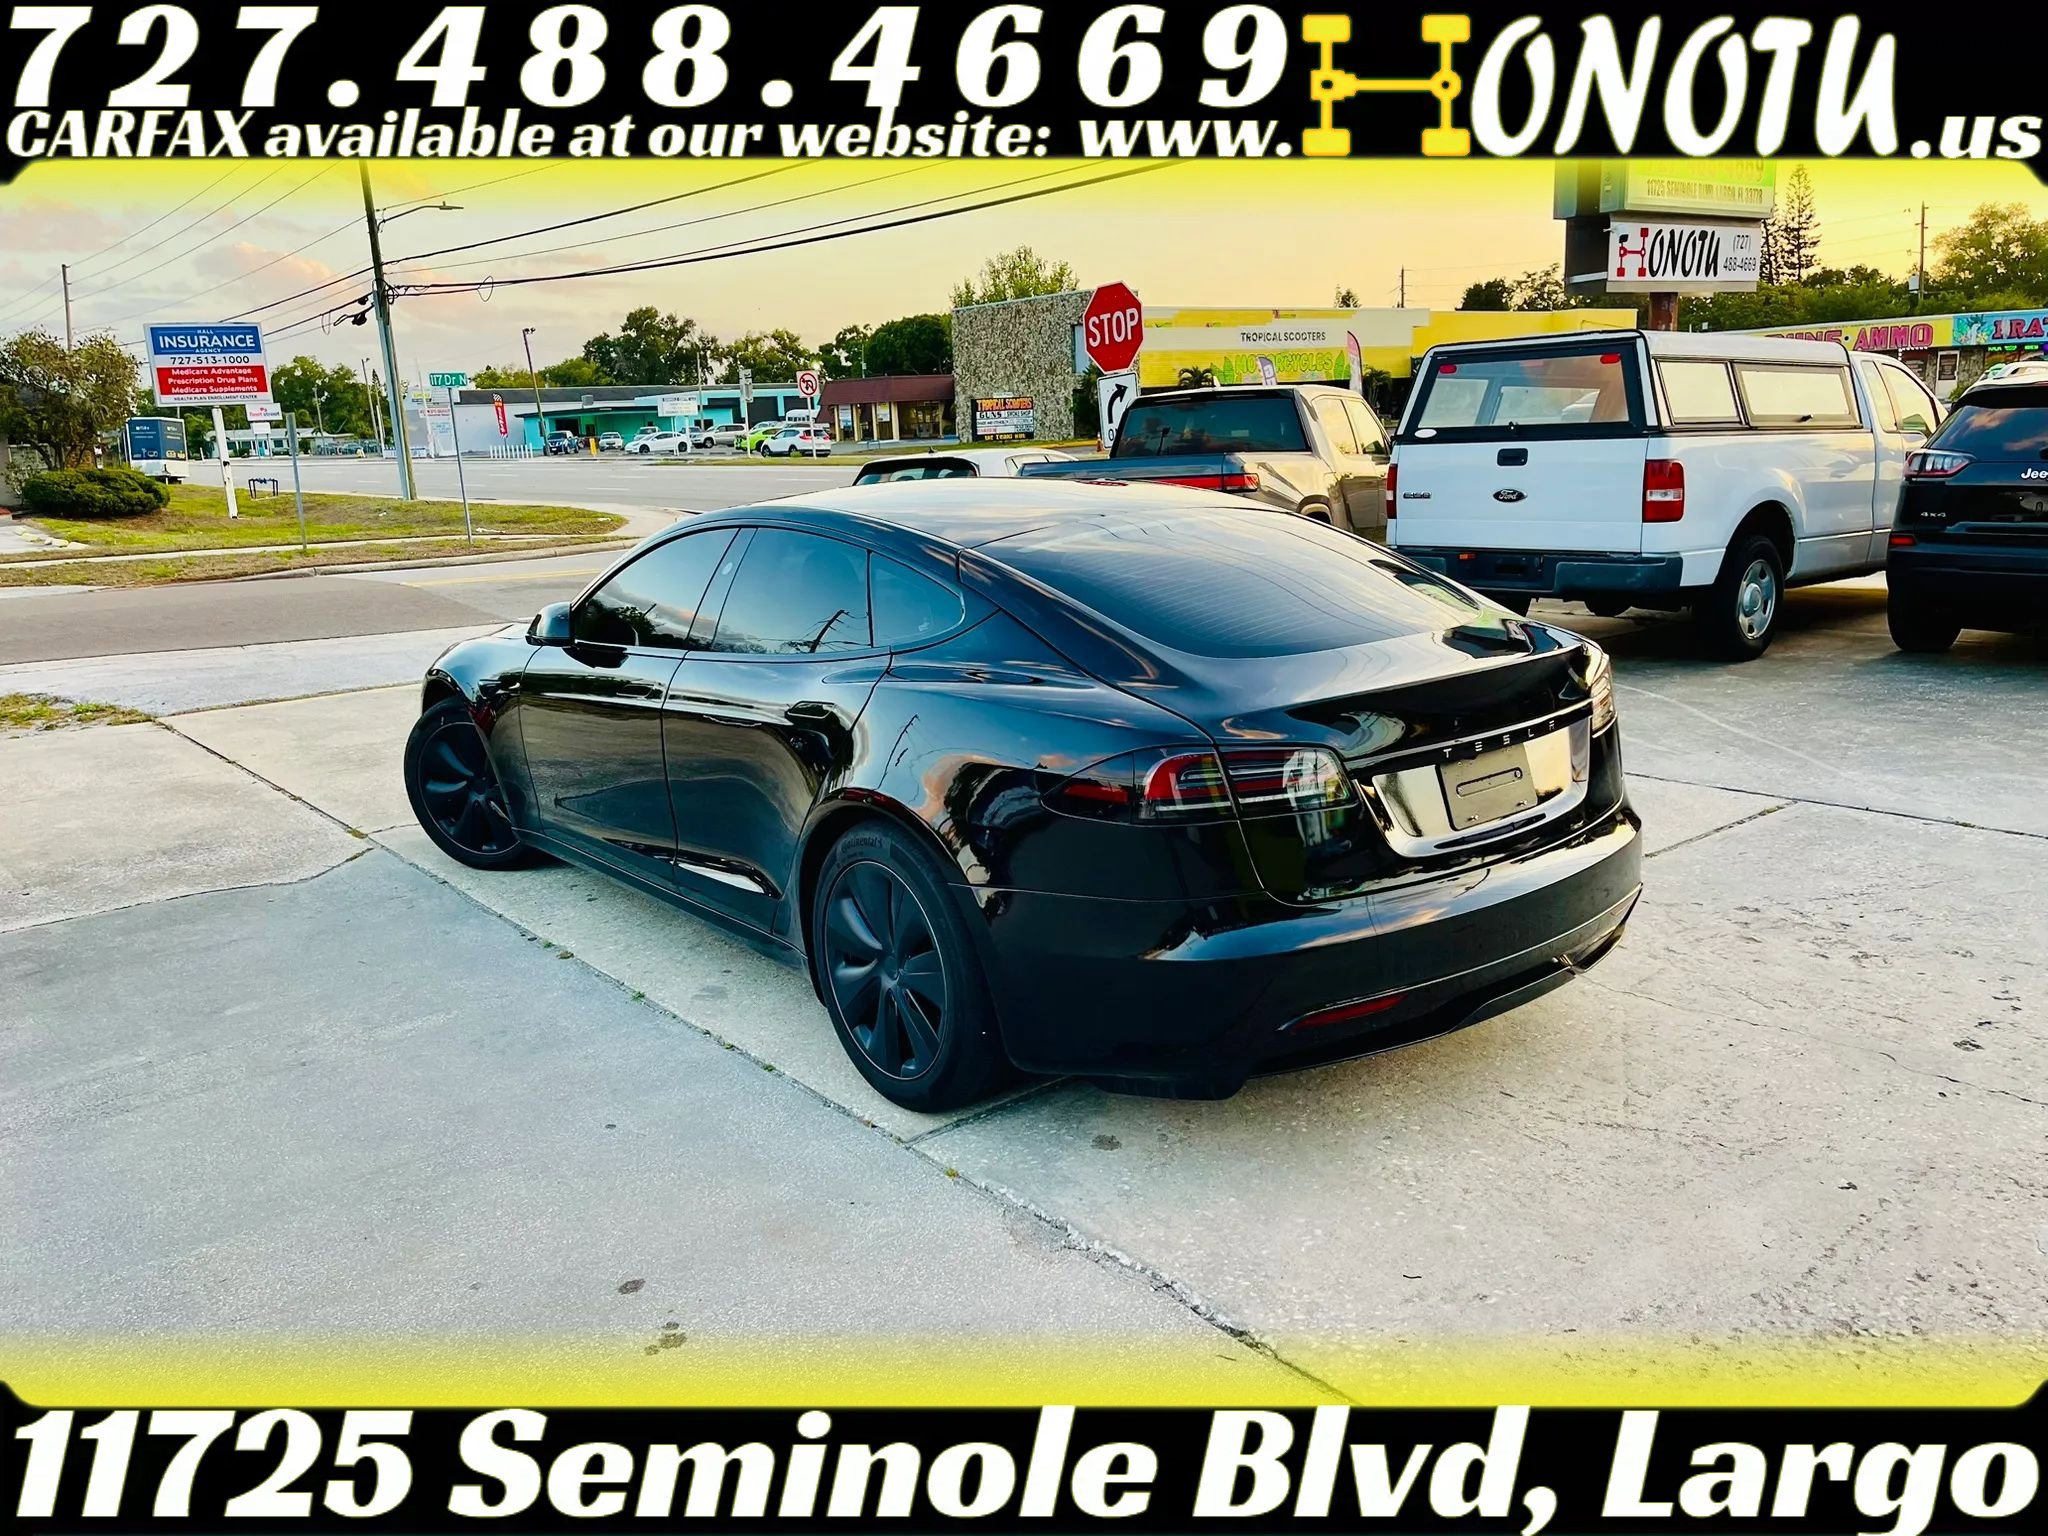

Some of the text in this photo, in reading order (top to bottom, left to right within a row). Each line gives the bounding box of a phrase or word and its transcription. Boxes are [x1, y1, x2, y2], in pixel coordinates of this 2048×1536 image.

[1733, 233, 1751, 253] (727)
[1723, 256, 1757, 272] 488-4669
[1088, 307, 1139, 348] STOP
[159, 335, 256, 348] INSURANCE
[1241, 331, 1327, 342] TROPICAL SCOOTERS
[1854, 323, 1933, 350] AMMO
[170, 356, 250, 365] 727-513-1000
[168, 377, 215, 385] Prescription
[430, 373, 467, 386] 117 Dr N
[209, 385, 258, 393] Supplements
[2021, 467, 2048, 481] Jee
[1499, 490, 1517, 500] Ford
[1443, 720, 1555, 758] TESLA
